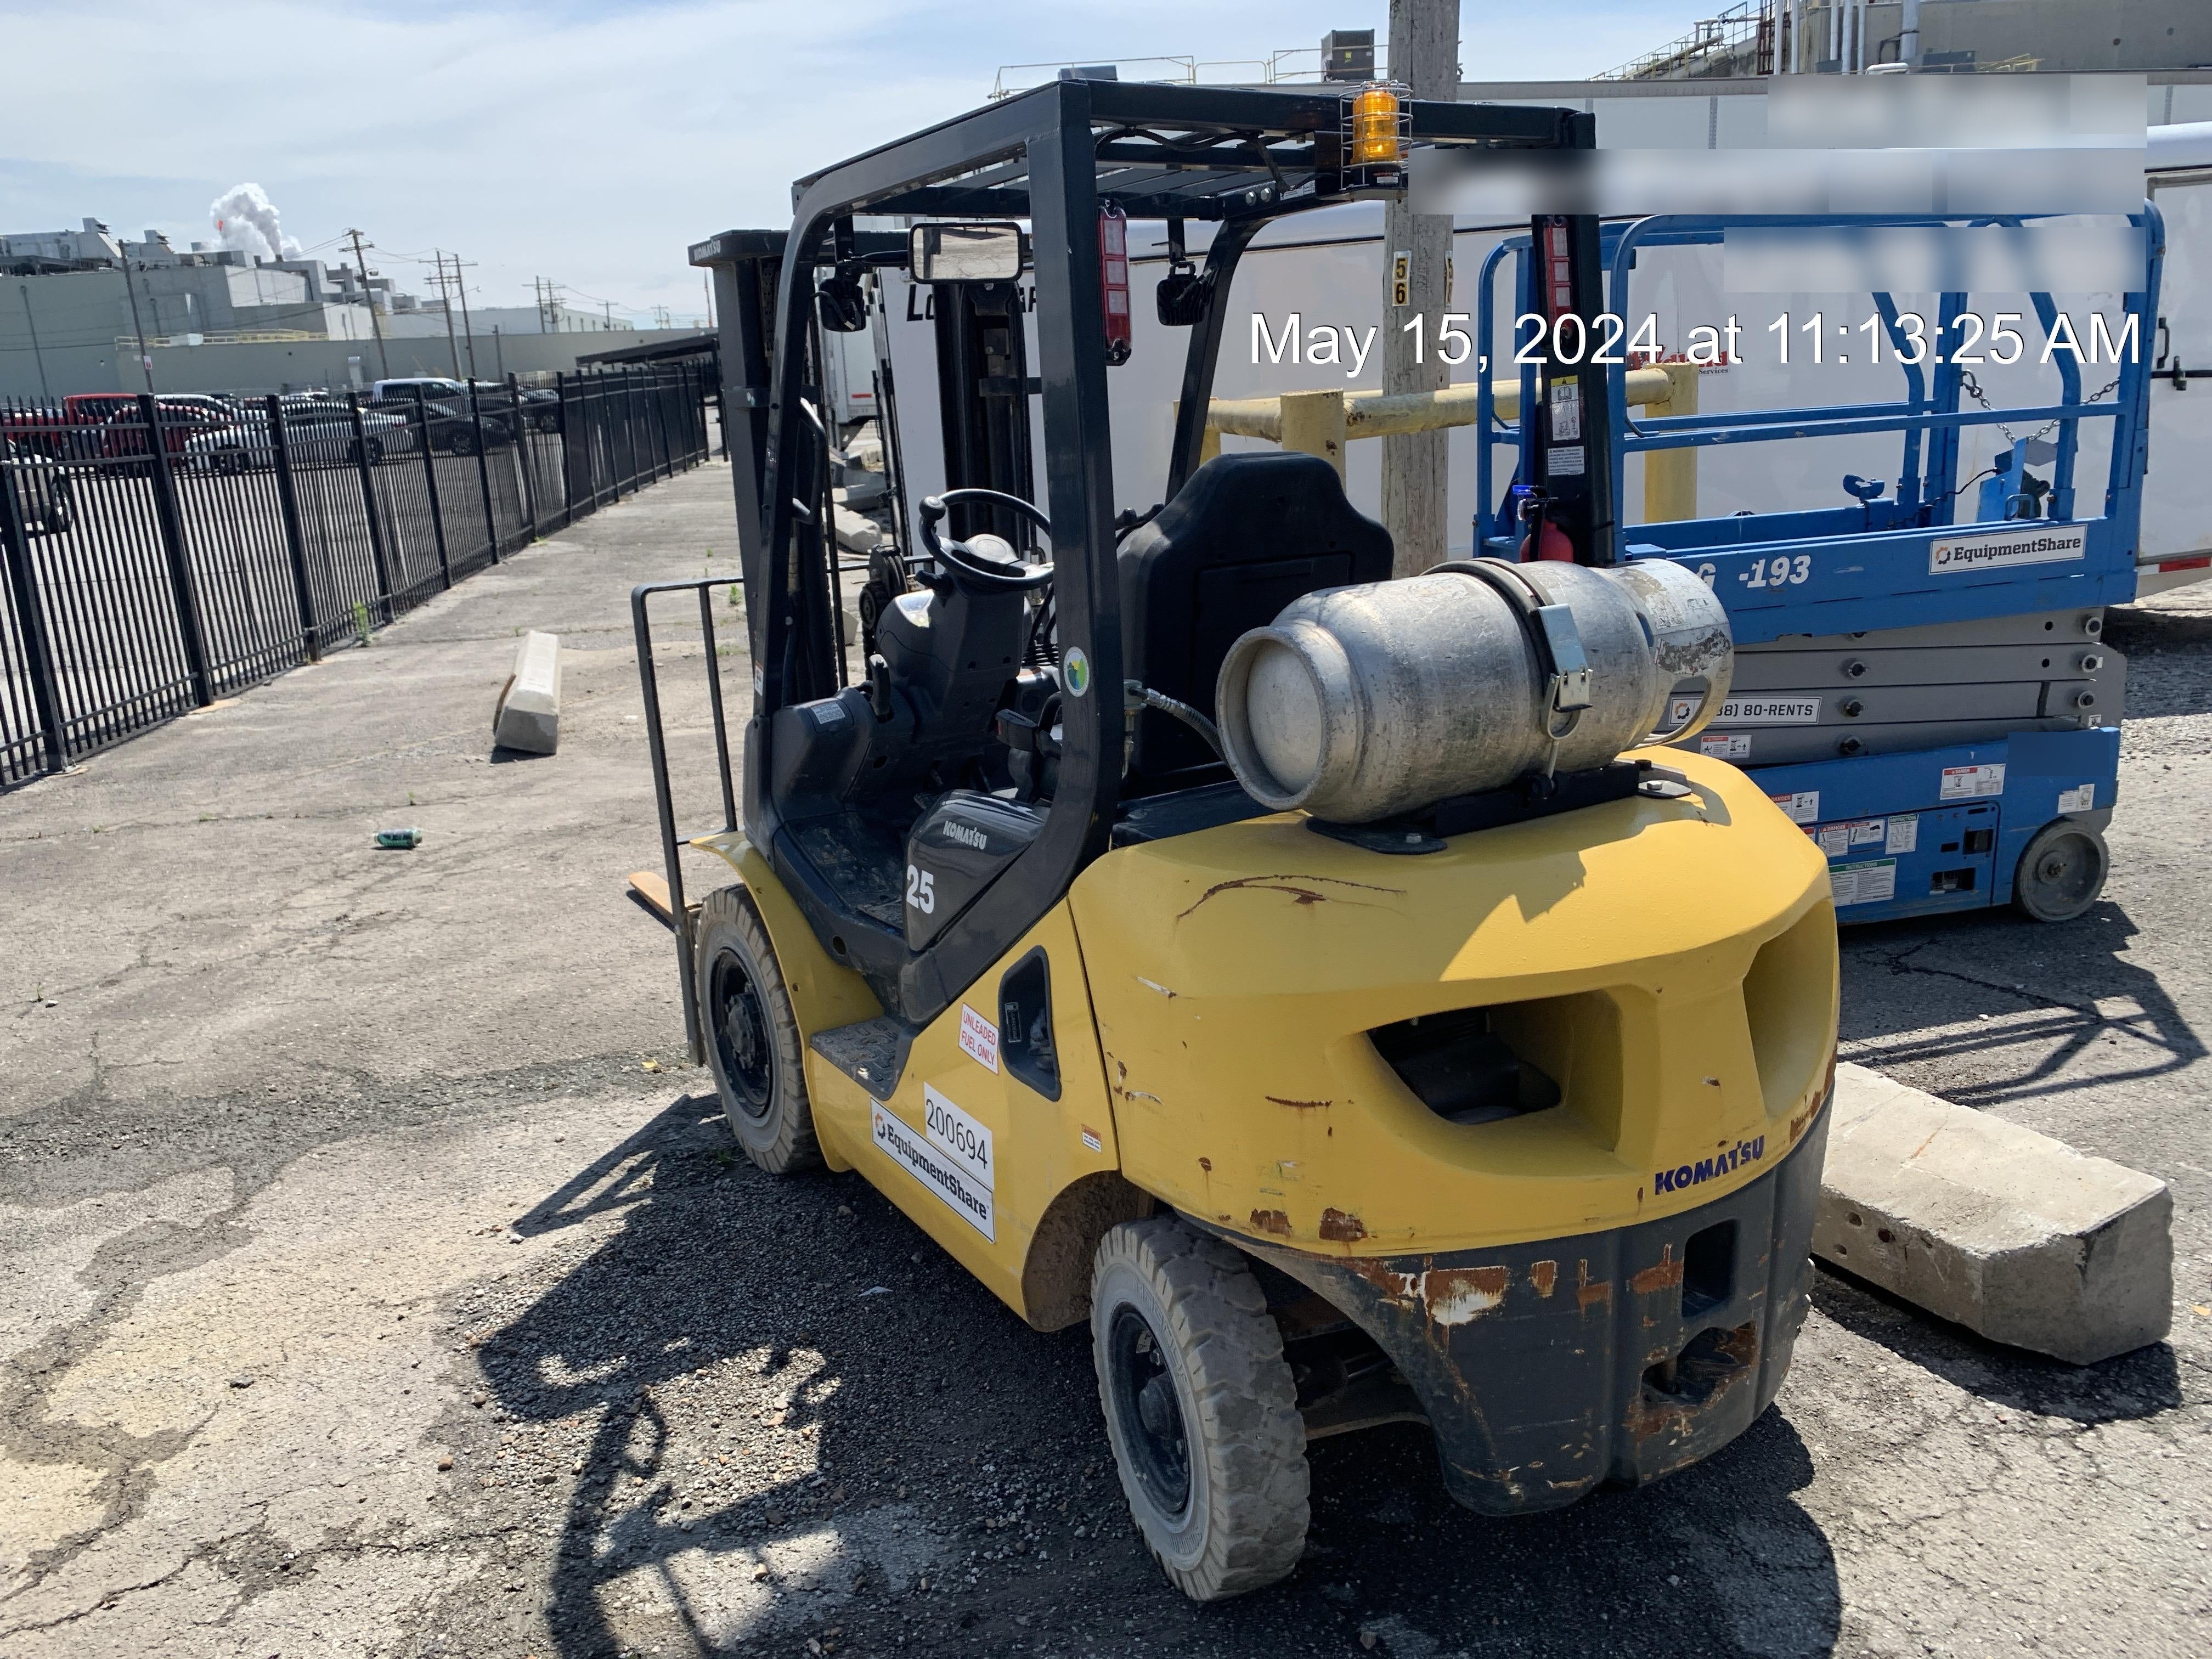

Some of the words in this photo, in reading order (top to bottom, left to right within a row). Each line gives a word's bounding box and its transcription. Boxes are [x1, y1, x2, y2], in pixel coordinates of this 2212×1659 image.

[1954, 538, 2081, 562] EquipmentShare
[1739, 555, 1811, 589] -193
[1743, 704, 1814, 716] 80-RENTS
[943, 820, 987, 850] KOMATSU
[1846, 861, 1877, 870] INSTRUCTIONS
[906, 864, 934, 914] 25
[963, 1011, 996, 1046] UNLEADED
[961, 1030, 975, 1052] FUEL
[978, 1044, 995, 1065] ONLY
[926, 1098, 988, 1170] 200694
[887, 1124, 987, 1220] EquipmentShare
[1655, 1135, 1764, 1195] KOMATSU
